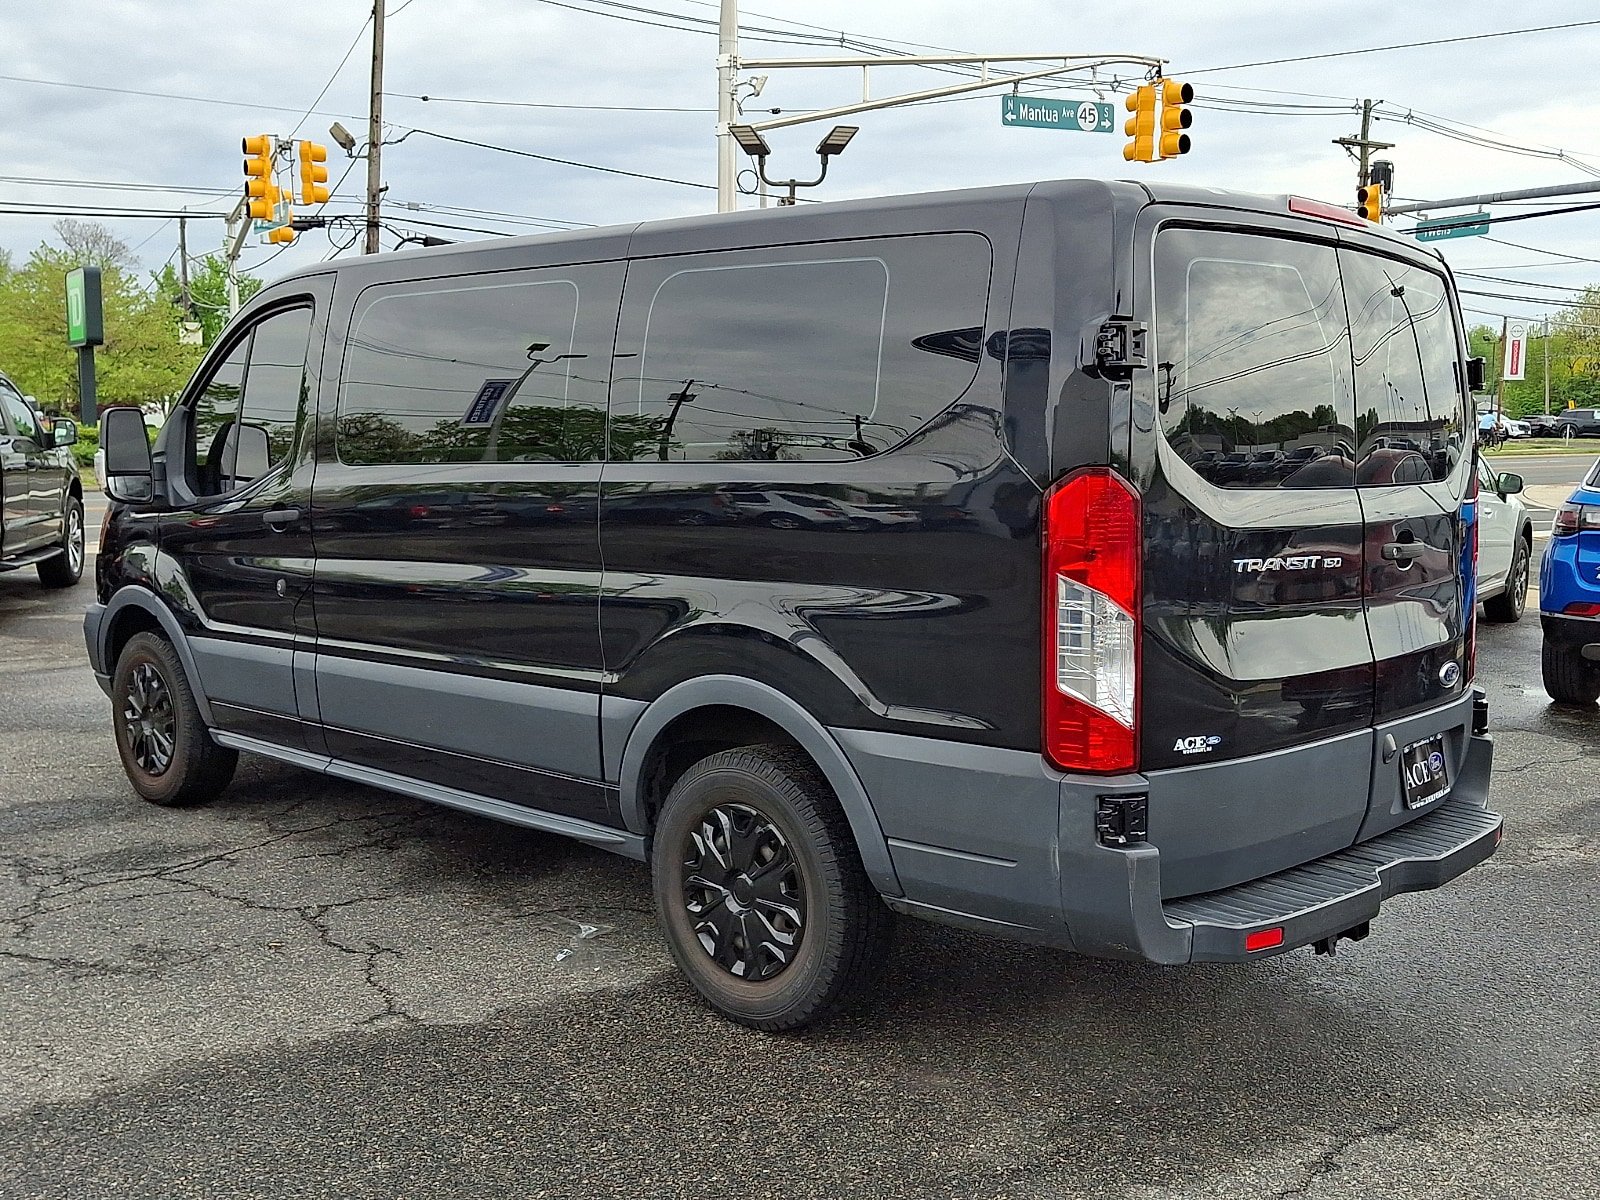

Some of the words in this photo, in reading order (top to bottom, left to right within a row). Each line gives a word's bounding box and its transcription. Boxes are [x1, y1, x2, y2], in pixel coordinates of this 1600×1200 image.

[1007, 99, 1014, 110] N
[1019, 103, 1059, 122] Mantua
[1061, 107, 1075, 118] Ave
[1104, 107, 1109, 118] S
[1079, 107, 1096, 124] 45
[1232, 556, 1322, 573] TRANSIT
[1173, 736, 1207, 751] ACE
[1406, 760, 1432, 790] ACE
